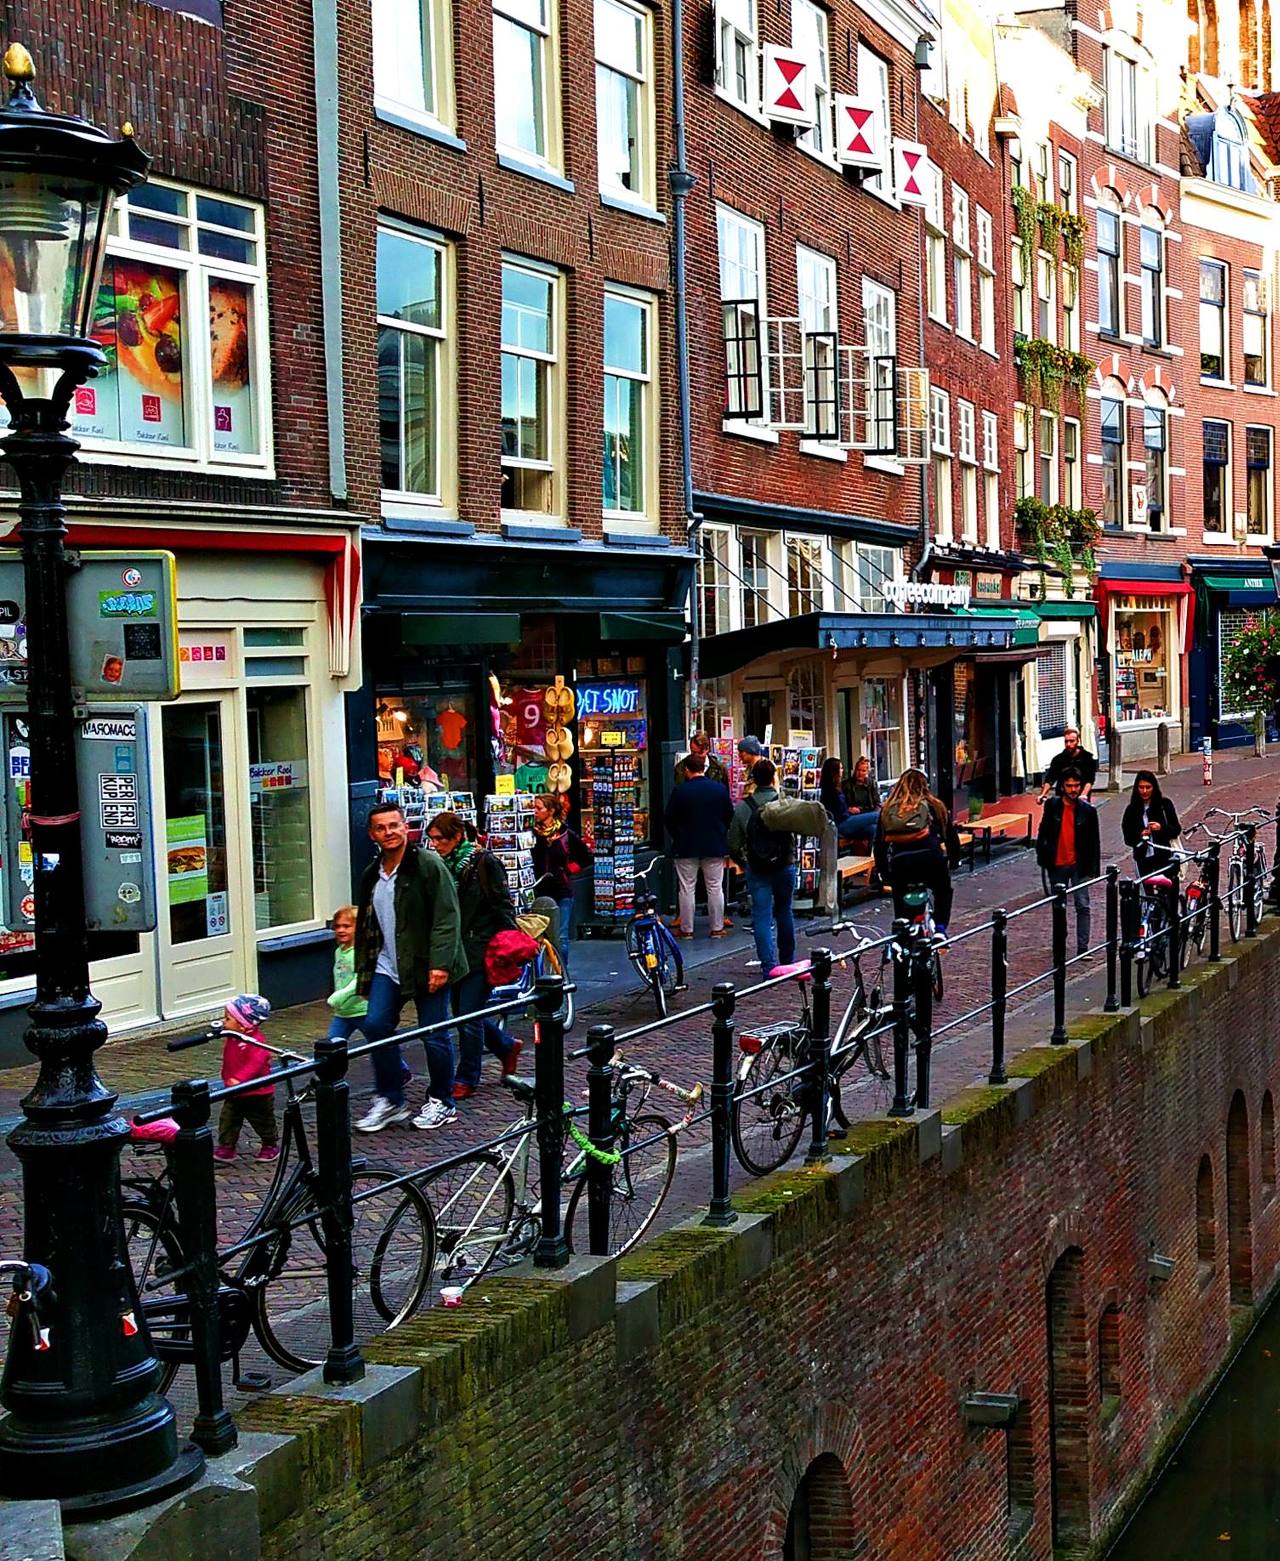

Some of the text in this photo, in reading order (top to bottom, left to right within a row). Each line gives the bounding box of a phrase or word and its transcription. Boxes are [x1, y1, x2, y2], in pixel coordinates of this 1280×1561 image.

[884, 576, 969, 609] coffeecompany
[524, 704, 540, 728] 9
[249, 763, 292, 778] Bakker Roel
[102, 777, 118, 798] KUP
[119, 777, 134, 798] PER
[104, 804, 119, 824] END
[120, 804, 135, 824] FRI
